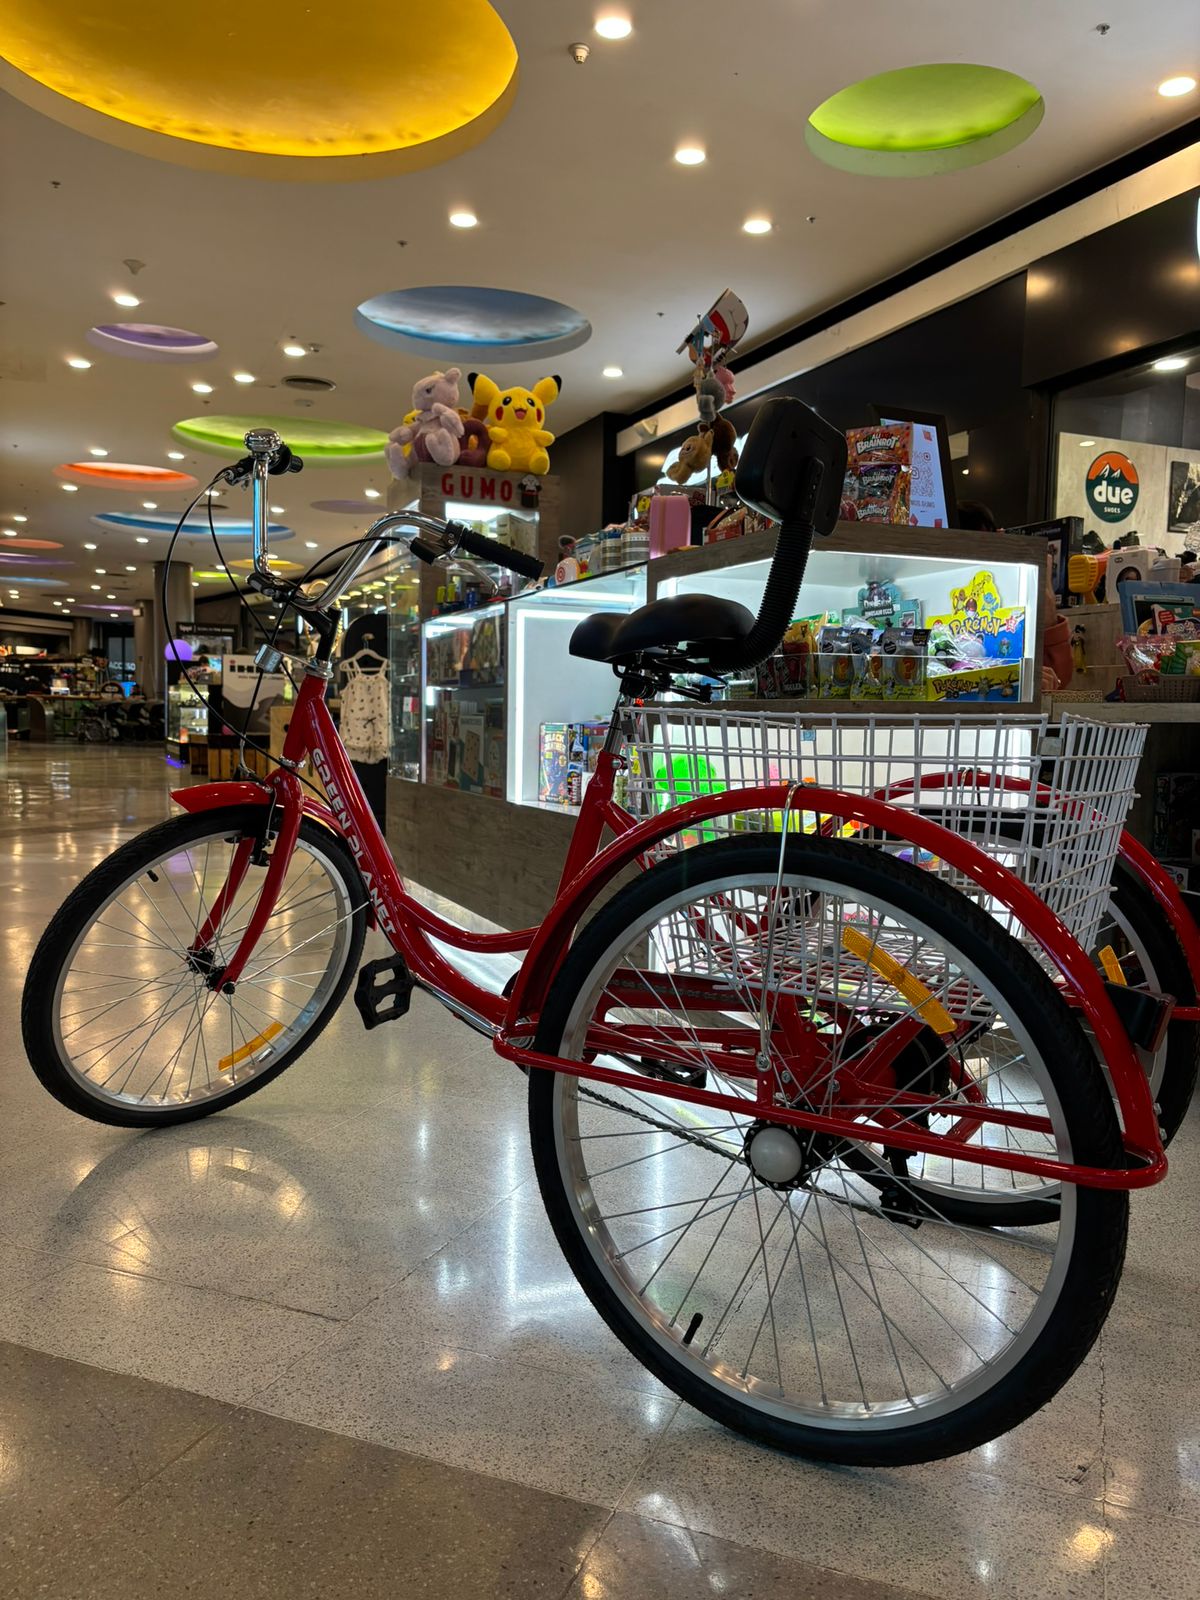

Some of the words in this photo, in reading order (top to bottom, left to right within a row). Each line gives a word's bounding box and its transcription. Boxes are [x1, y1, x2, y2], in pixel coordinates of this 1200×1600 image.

[856, 436, 899, 455] BRAINROT
[441, 473, 513, 502] GUMO
[862, 475, 895, 485] BRAINROT
[1093, 480, 1133, 505] due
[857, 506, 889, 520] BRAINROT
[1104, 506, 1121, 514] SHOES
[312, 748, 352, 831] GREEN
[347, 836, 397, 934] PLANET
